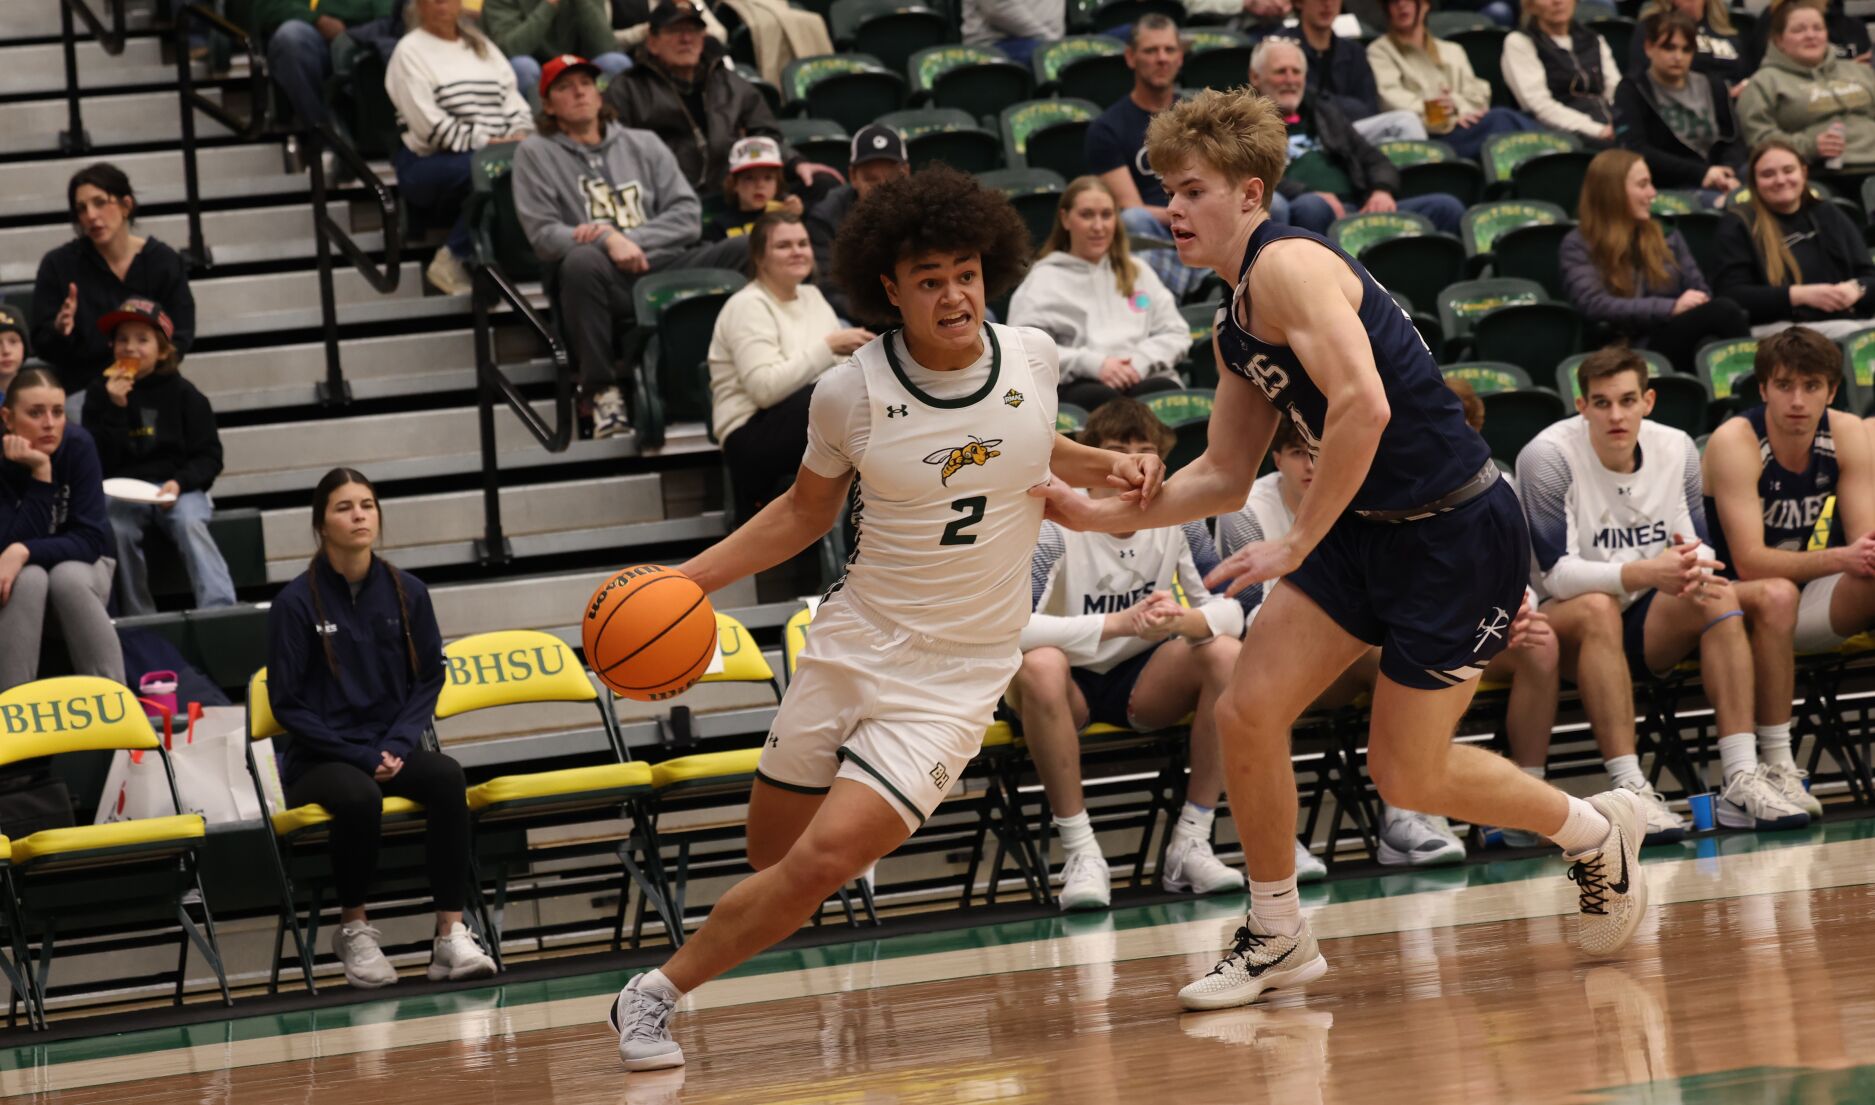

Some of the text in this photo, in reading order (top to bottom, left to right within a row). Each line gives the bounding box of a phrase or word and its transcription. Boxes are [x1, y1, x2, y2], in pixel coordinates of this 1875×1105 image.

[939, 495, 988, 546] 2
[1764, 492, 1831, 530] INE
[1592, 520, 1667, 549] MINES
[446, 644, 565, 686] BHSU
[0, 691, 126, 734] BHSU
[929, 761, 950, 790] BH
